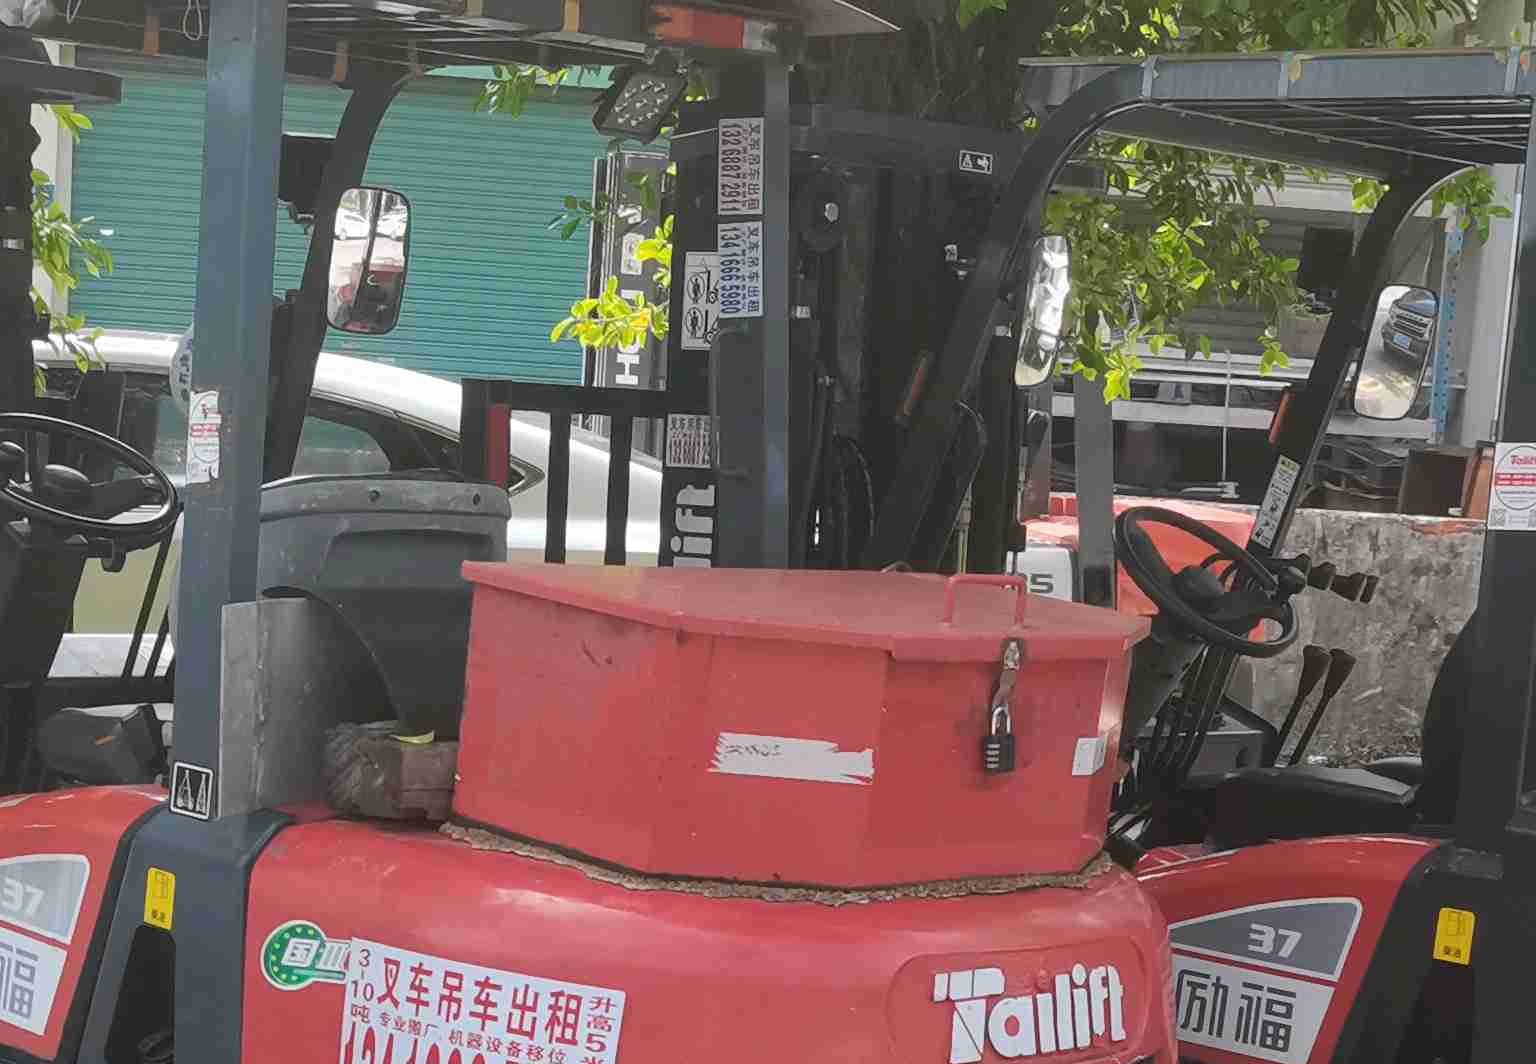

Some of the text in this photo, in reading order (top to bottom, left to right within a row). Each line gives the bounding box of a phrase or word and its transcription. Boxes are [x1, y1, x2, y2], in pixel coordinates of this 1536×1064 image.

[0, 877, 47, 915] 37
[1247, 922, 1303, 961] 37
[377, 957, 584, 1046] 叉车吊车出租
